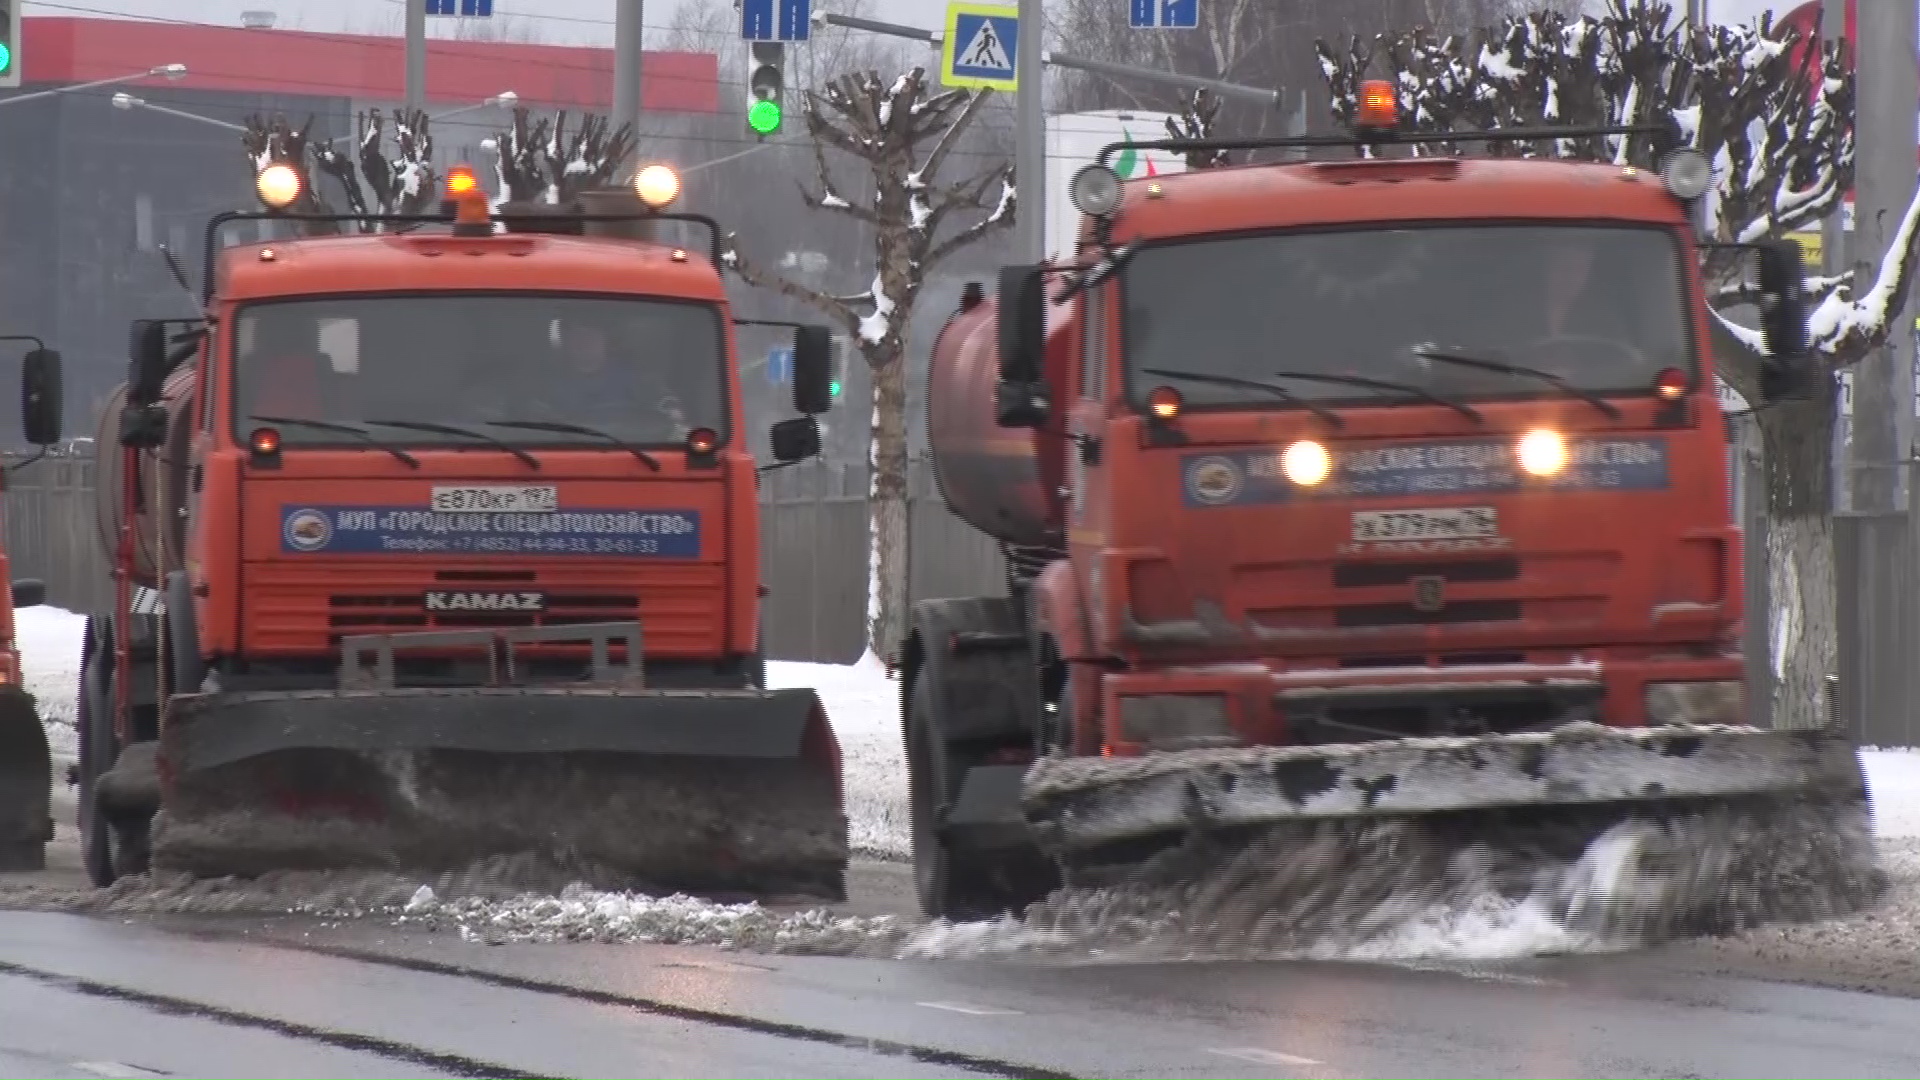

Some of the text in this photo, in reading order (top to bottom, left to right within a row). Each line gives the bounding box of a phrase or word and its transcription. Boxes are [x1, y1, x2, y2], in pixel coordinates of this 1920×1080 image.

[1247, 454, 1284, 477] МУ
[337, 510, 693, 537] МУП «ГОРОДСКОЕ СПЕЦАВТОХОЗЯЙСТВО»
[381, 535, 448, 552] Телефон:
[453, 537, 471, 550] +7
[475, 537, 520, 552] (4852)
[595, 538, 658, 553] 30-61-33
[426, 591, 542, 610] KAMAZ
